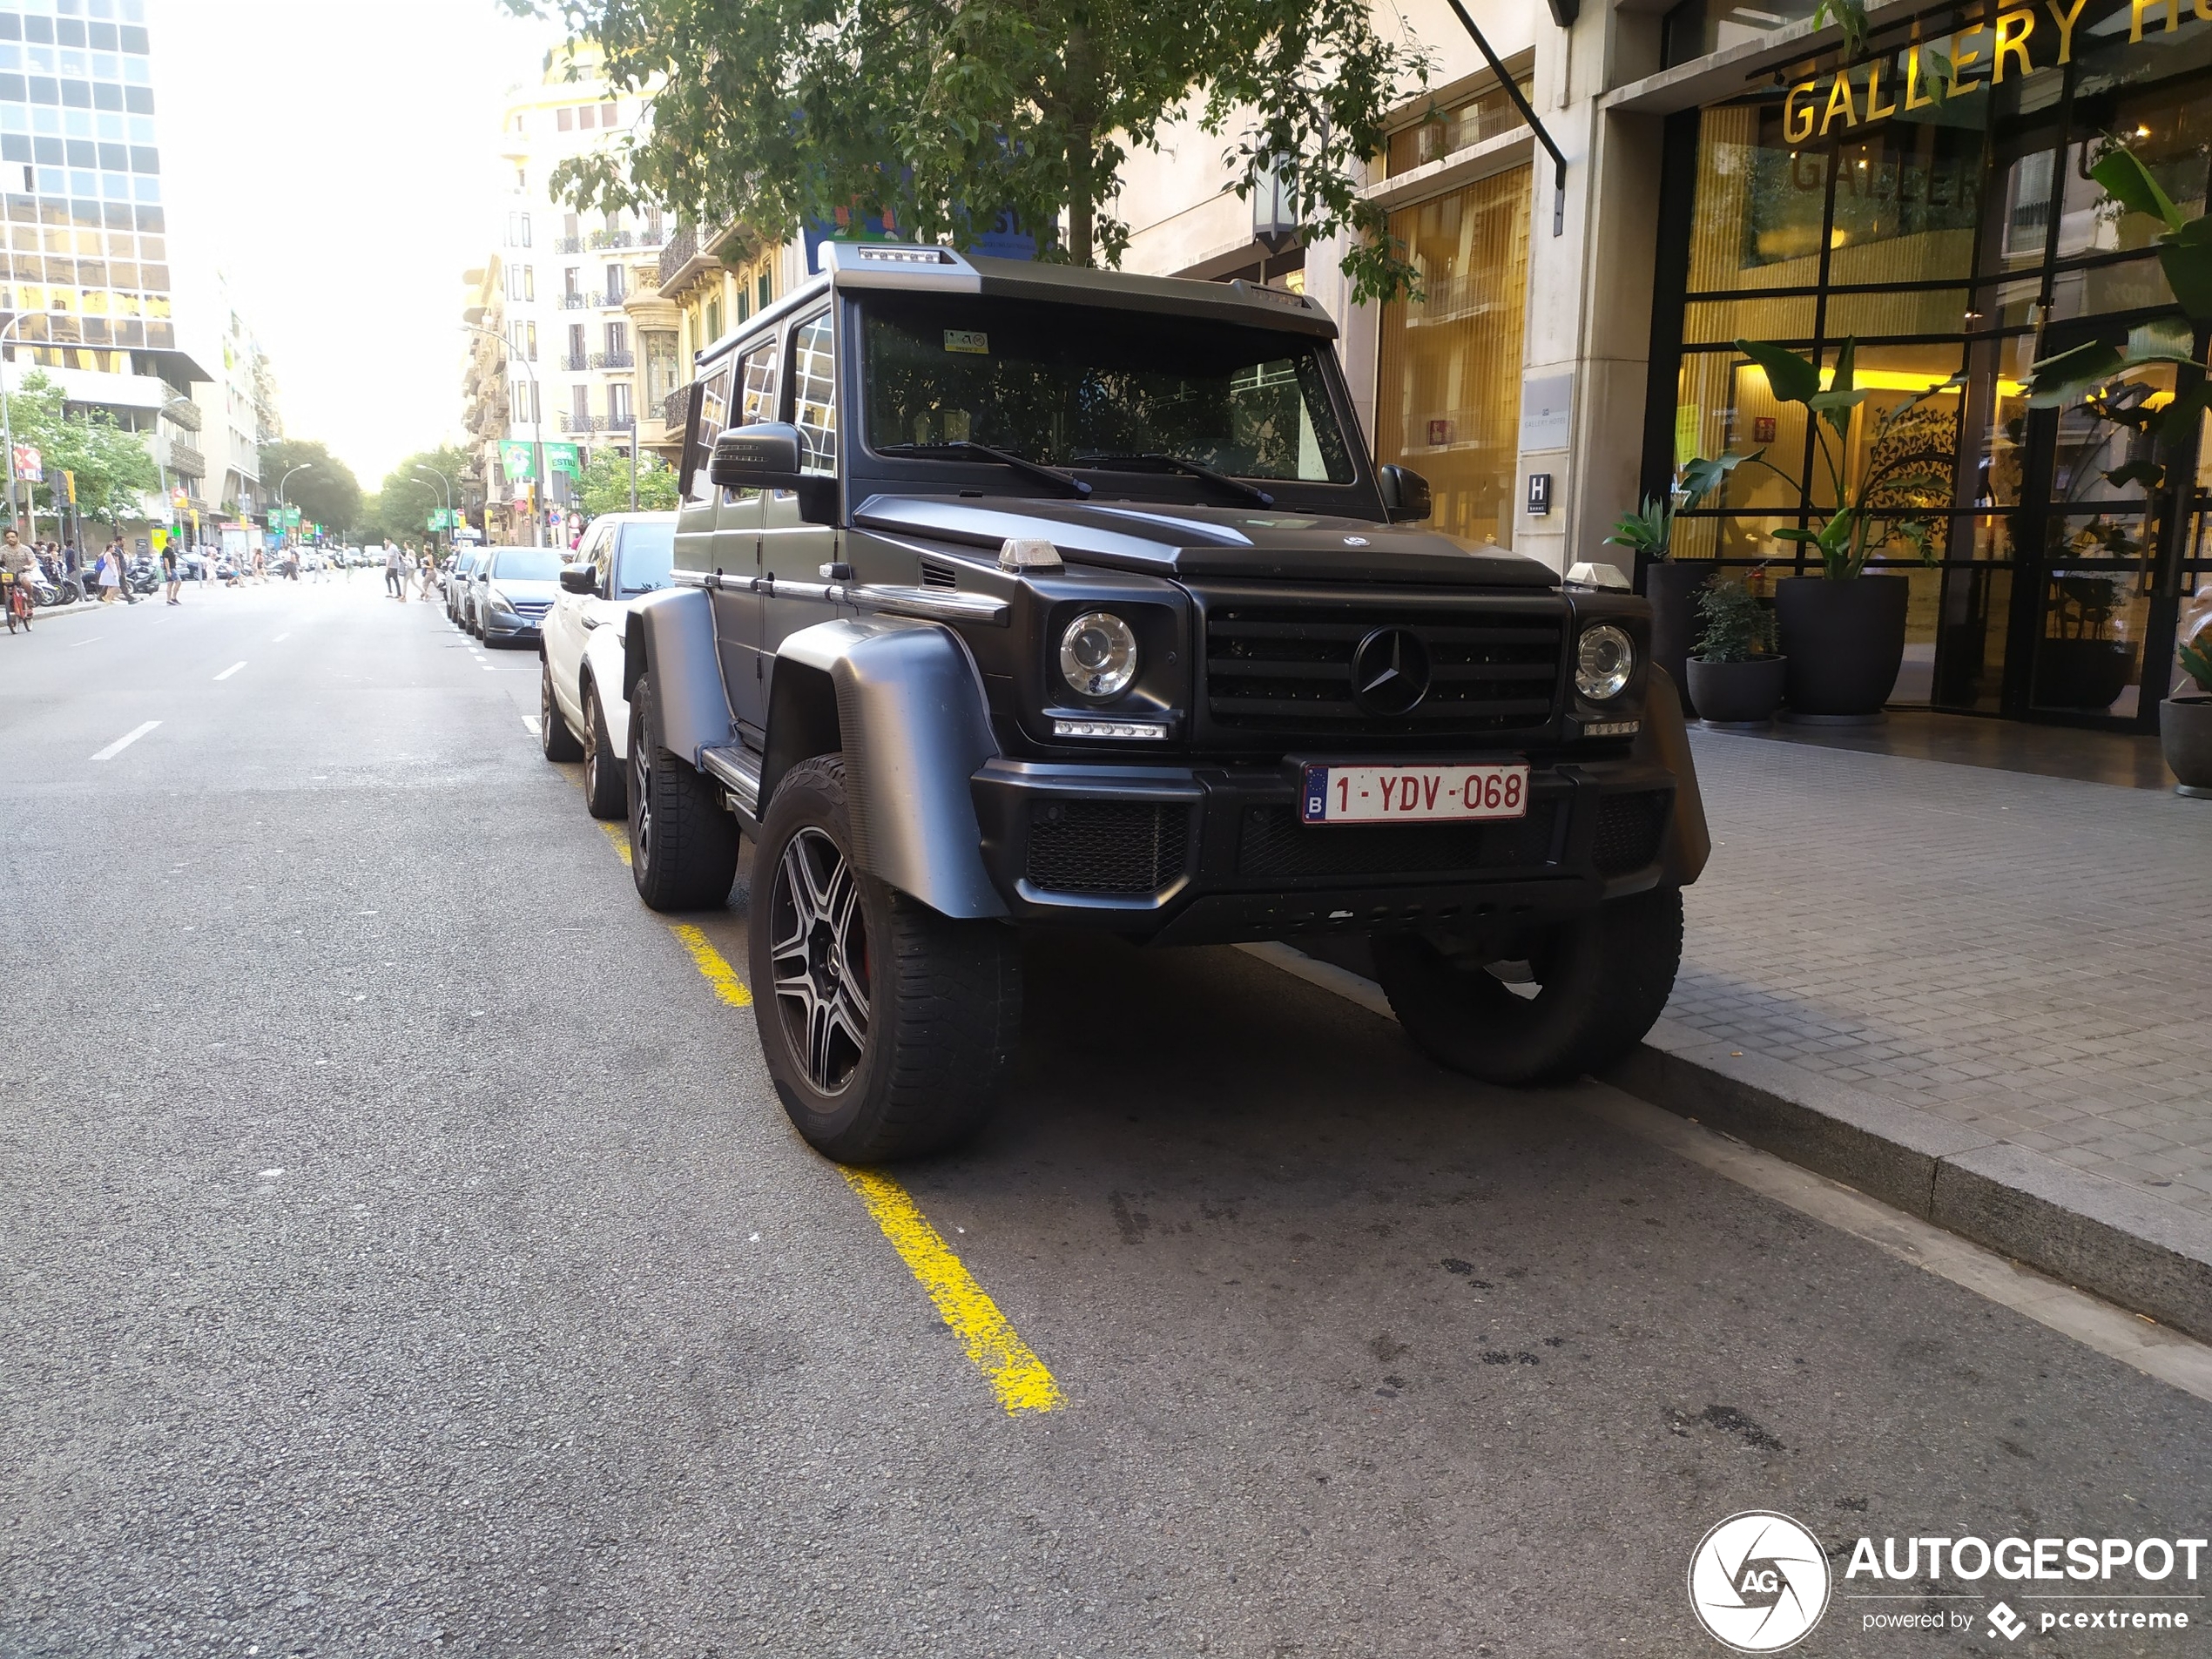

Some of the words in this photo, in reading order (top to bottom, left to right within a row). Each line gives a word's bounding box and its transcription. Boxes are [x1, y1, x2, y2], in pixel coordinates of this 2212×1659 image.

[1783, 0, 2088, 144] GALLERY
[1531, 477, 1544, 500] H
[1309, 797, 1322, 813] B
